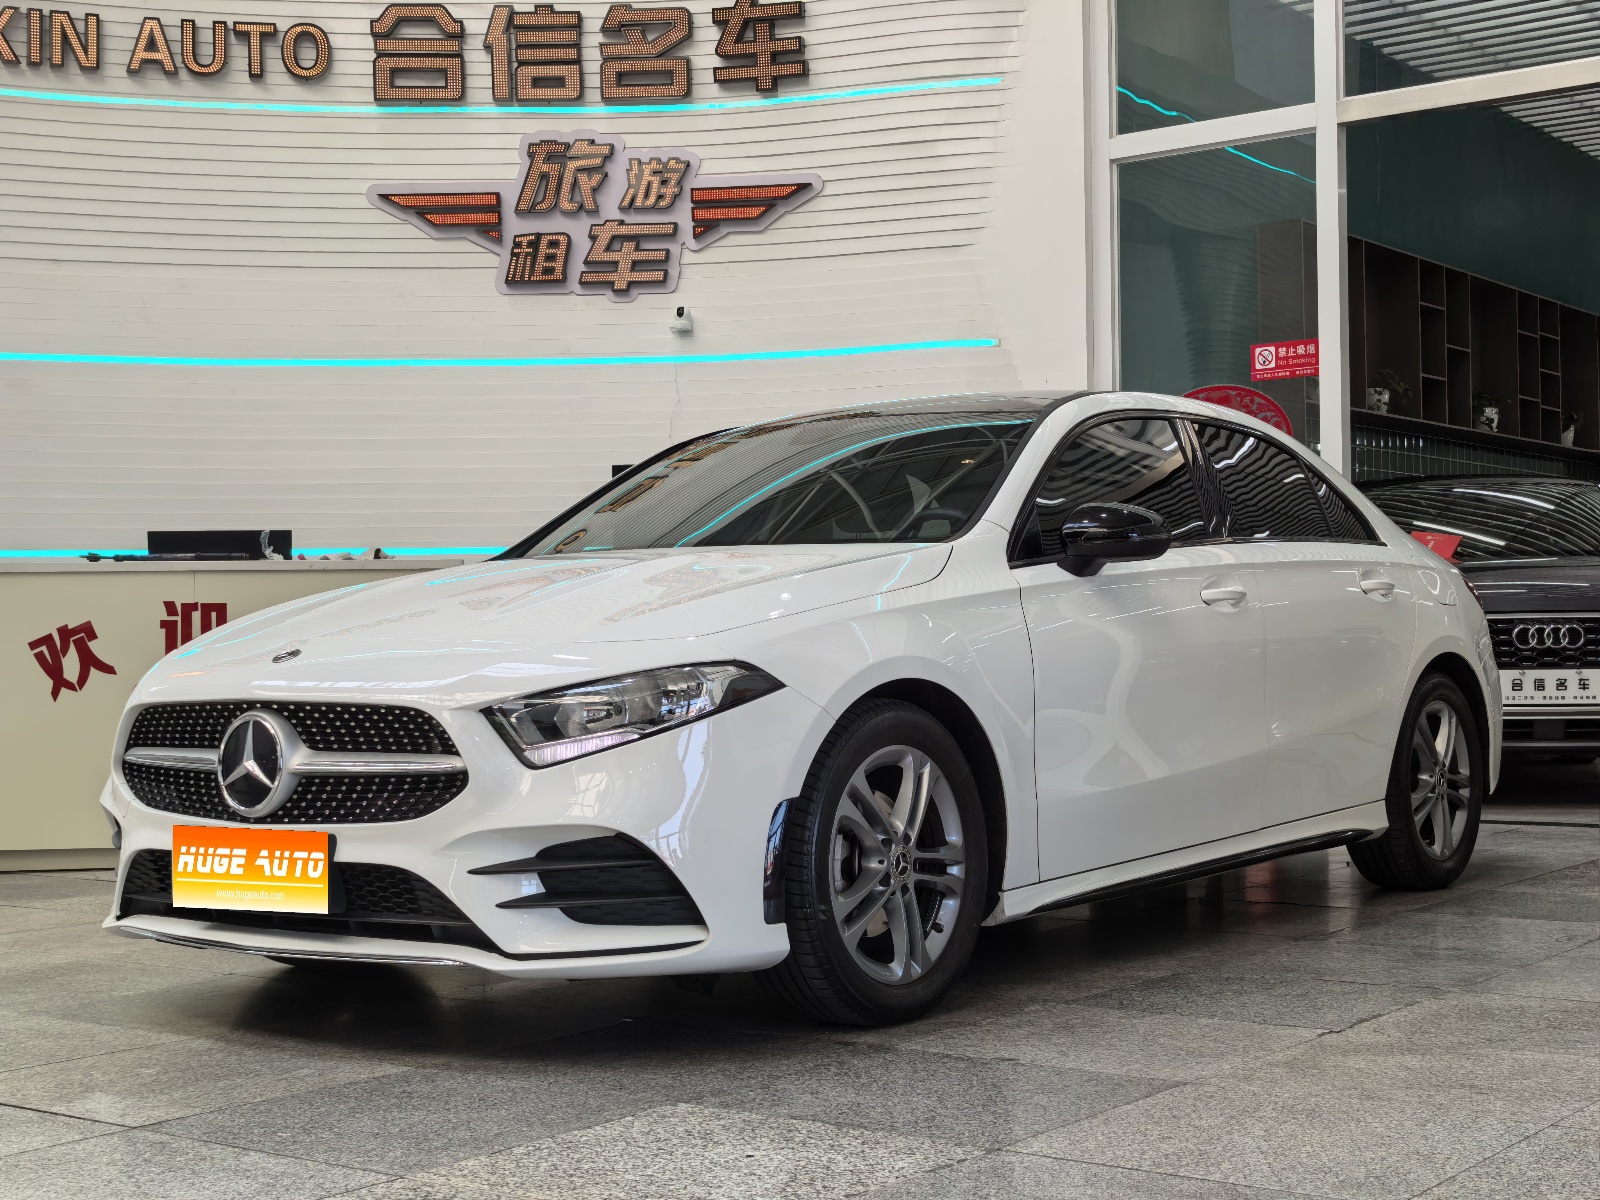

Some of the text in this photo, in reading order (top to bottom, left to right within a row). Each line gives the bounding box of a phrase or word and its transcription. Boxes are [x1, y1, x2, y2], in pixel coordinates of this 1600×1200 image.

[126, 17, 331, 79] AUTO
[370, 0, 808, 102] 合信名车
[514, 139, 690, 213] 旅游
[504, 219, 677, 292] 租车
[1277, 343, 1316, 357] 禁止吸烟
[1288, 357, 1316, 366] Smoking
[1511, 678, 1590, 692] 合信名车
